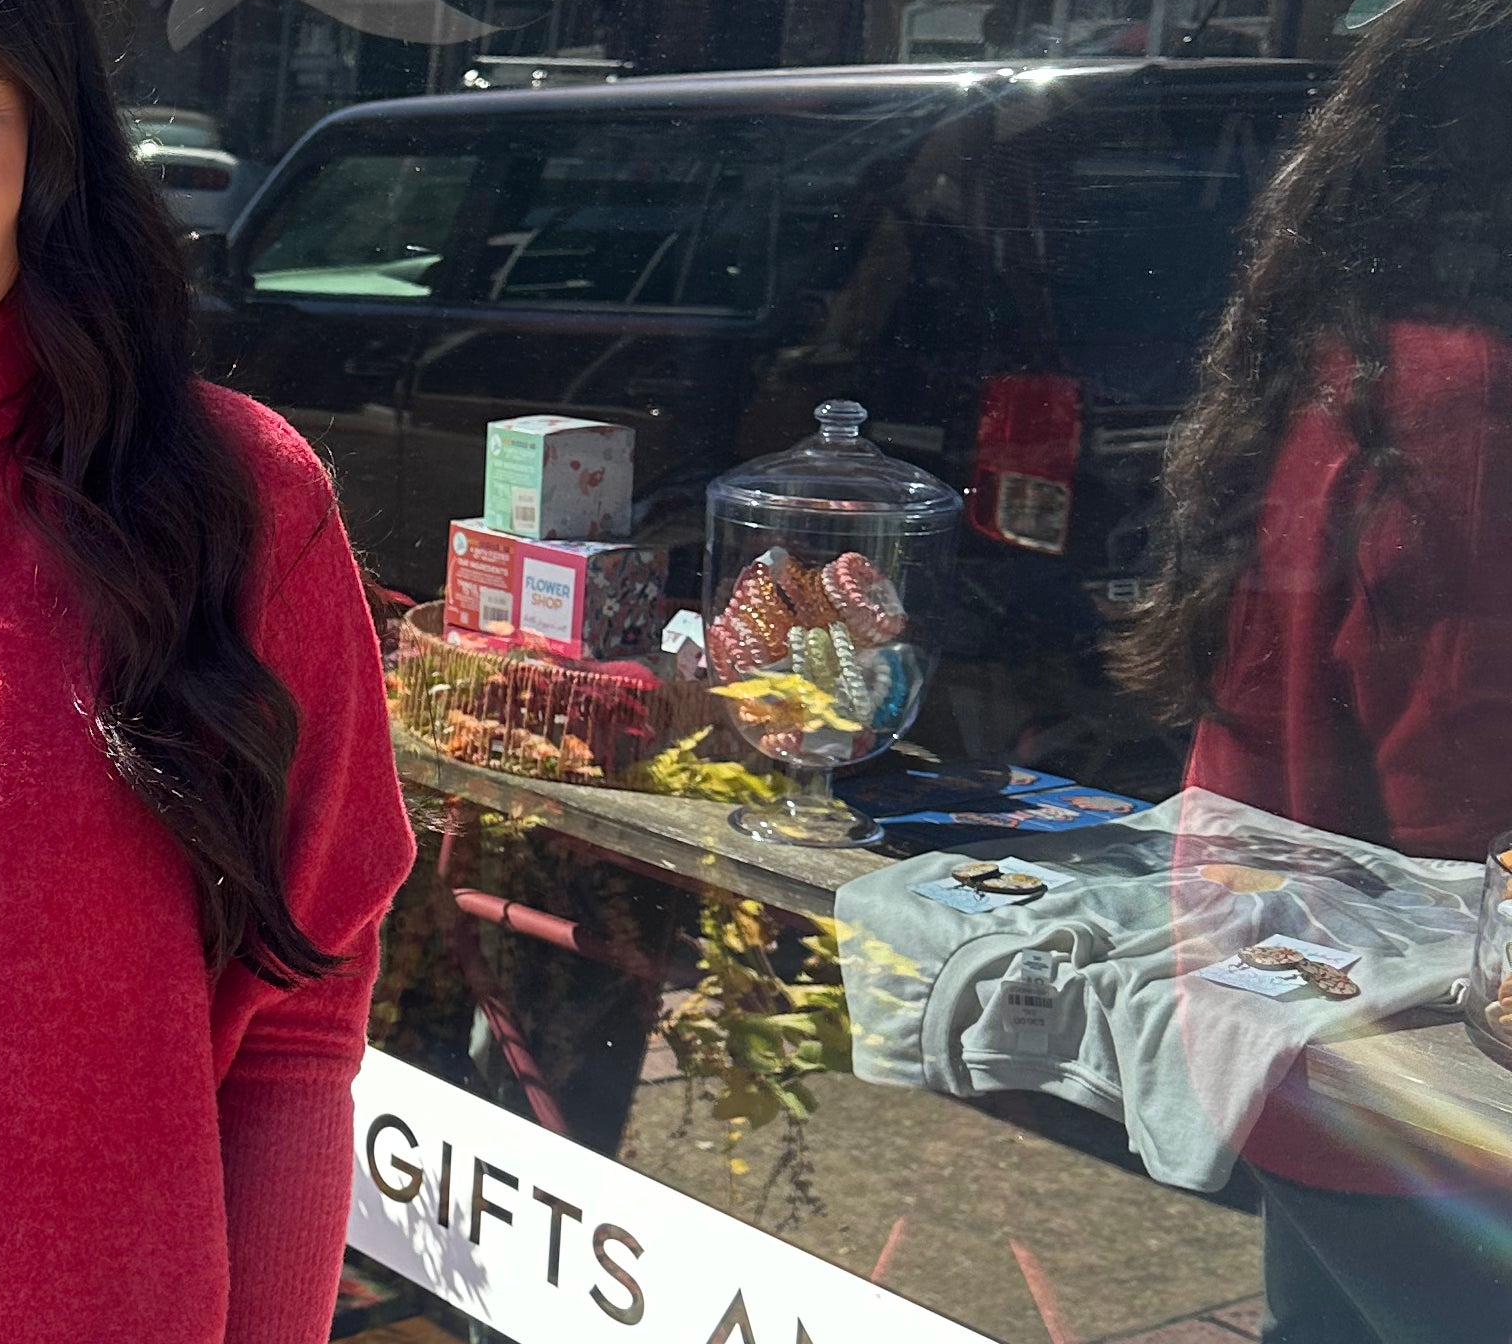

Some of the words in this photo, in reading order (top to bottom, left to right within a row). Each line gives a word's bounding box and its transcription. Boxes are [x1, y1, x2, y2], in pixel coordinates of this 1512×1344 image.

[525, 576, 570, 599] FLOWER
[531, 592, 563, 609] SHOP
[366, 1113, 645, 1326] GIFTS
